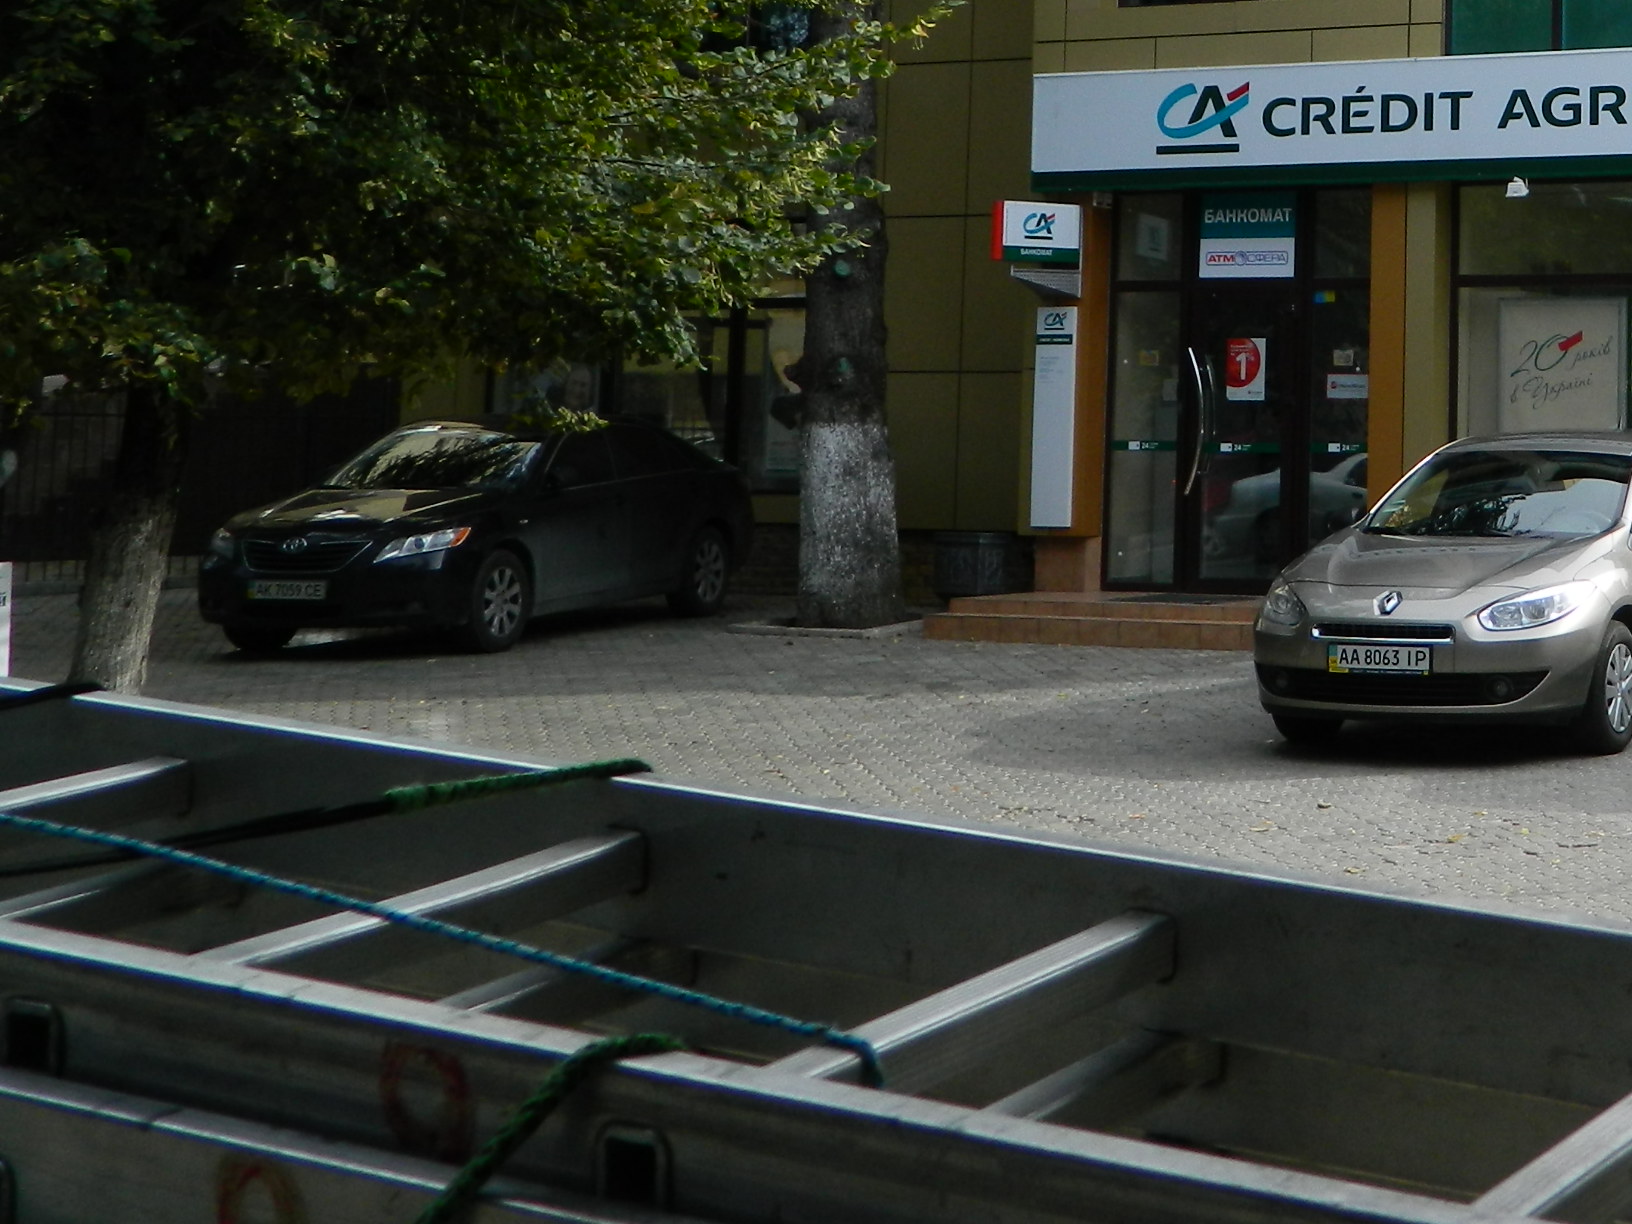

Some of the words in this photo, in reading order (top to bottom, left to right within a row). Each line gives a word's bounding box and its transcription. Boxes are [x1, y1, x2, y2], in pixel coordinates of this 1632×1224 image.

[1262, 86, 1474, 137] CRÉDIT
[1204, 207, 1292, 224] БАНКОМАТ
[1510, 332, 1574, 378] 20
[1567, 335, 1614, 369] років
[1523, 373, 1593, 410] Україні
[305, 583, 321, 597] CE
[1339, 648, 1360, 665] AA
[1364, 649, 1400, 666] 8063
[1407, 650, 1427, 667] IP
